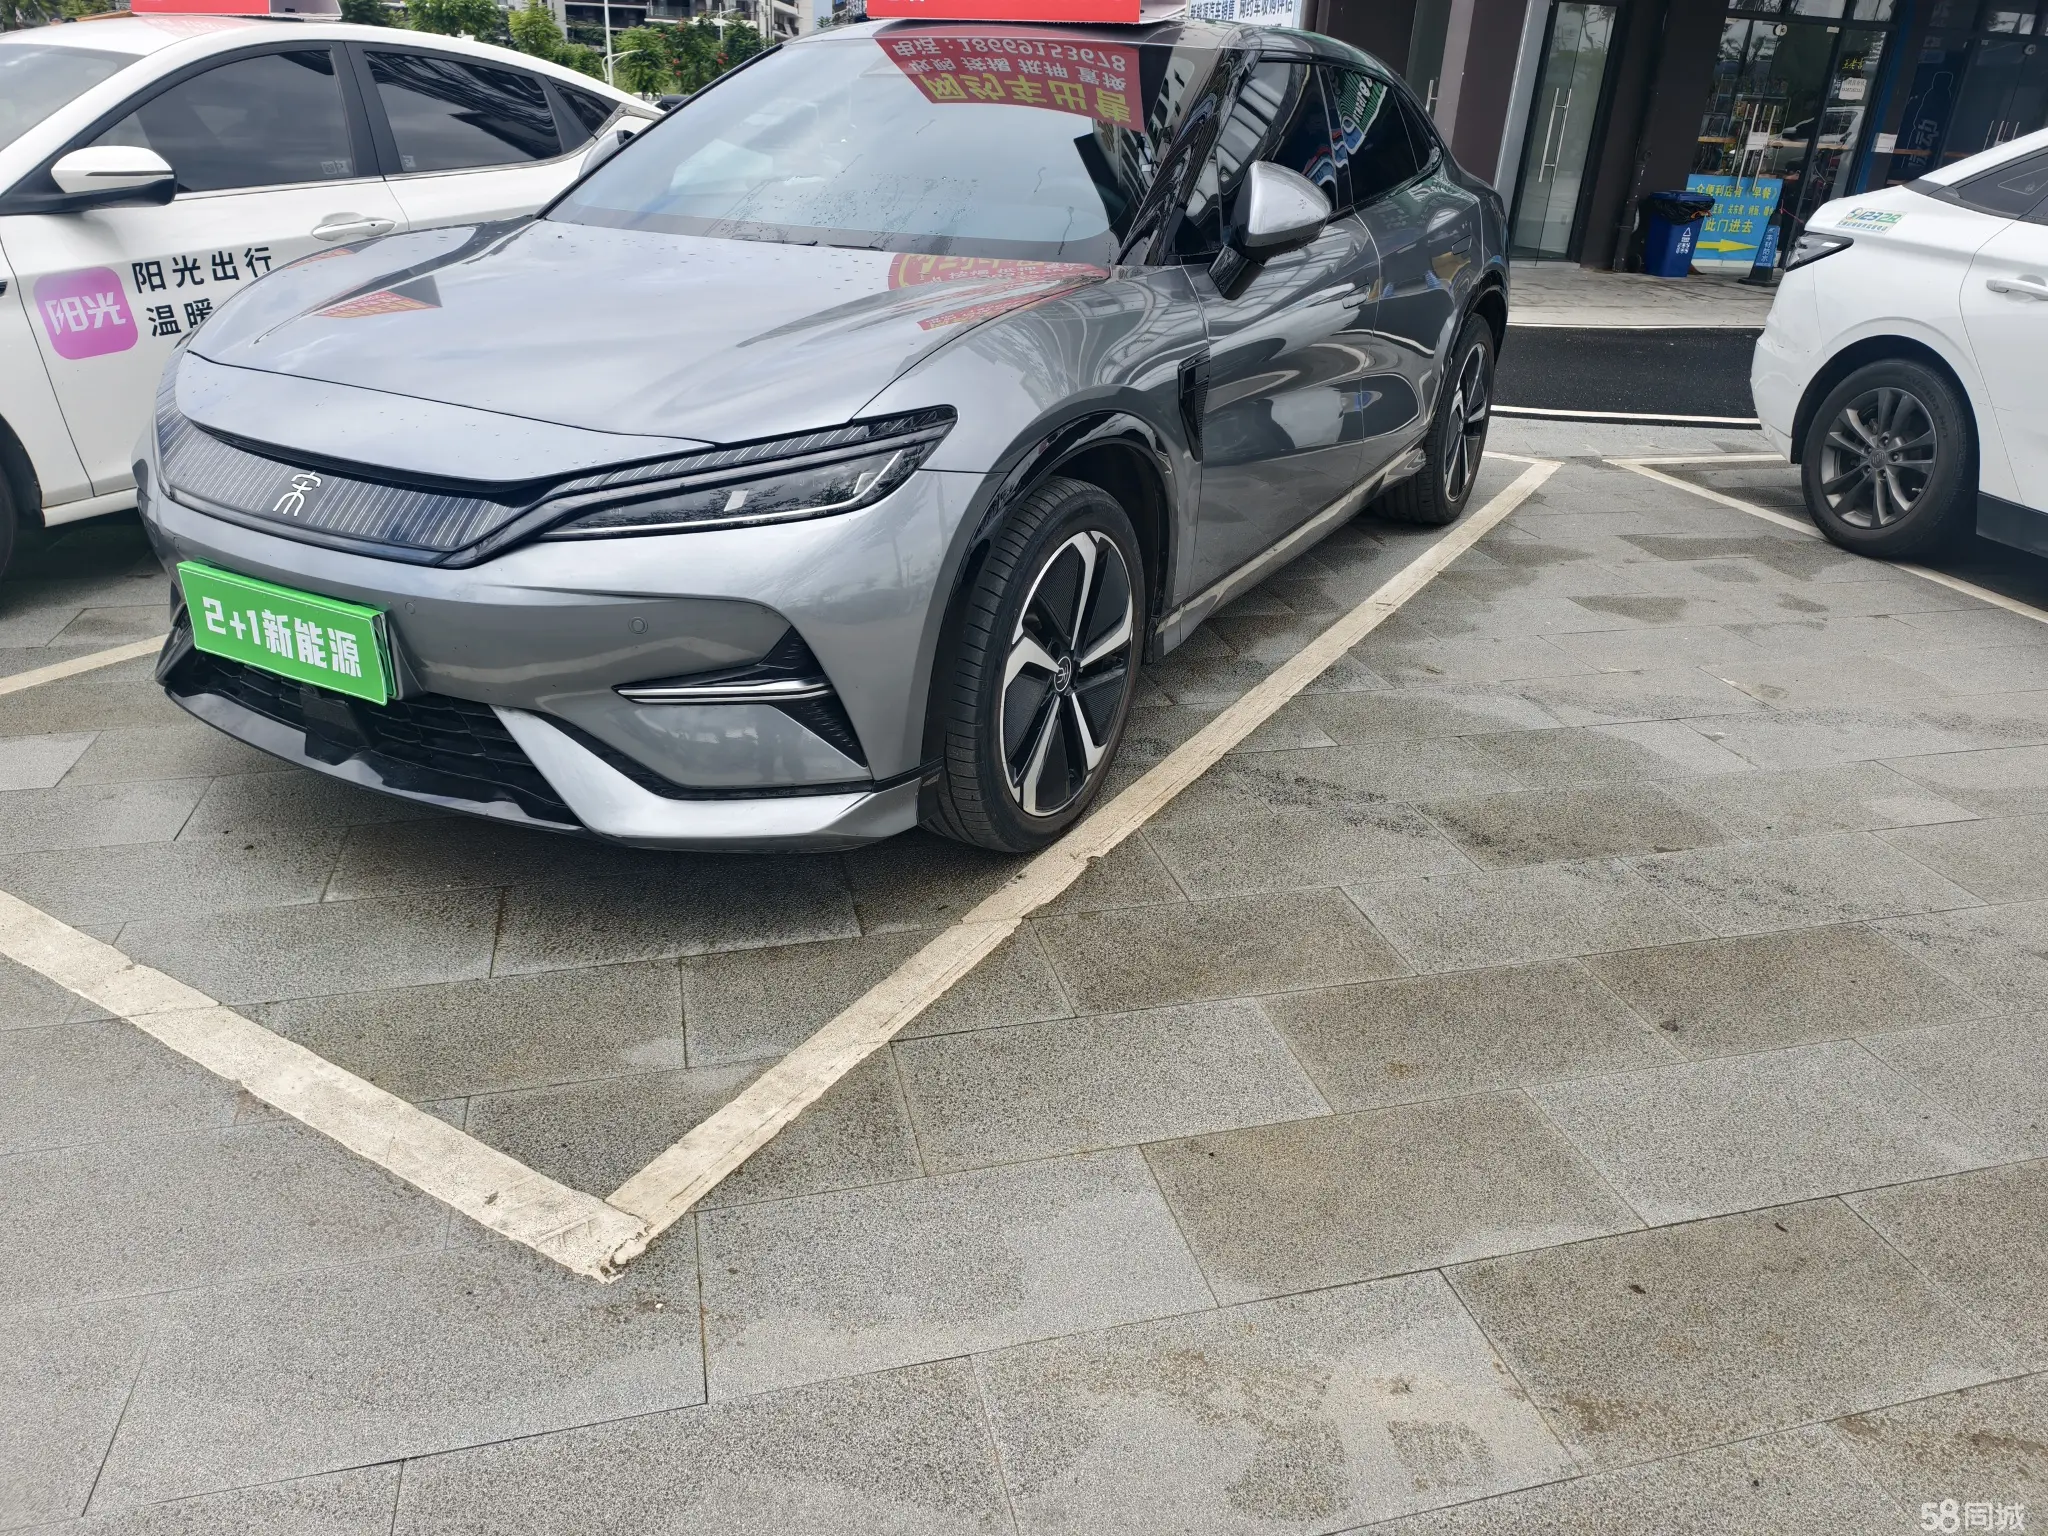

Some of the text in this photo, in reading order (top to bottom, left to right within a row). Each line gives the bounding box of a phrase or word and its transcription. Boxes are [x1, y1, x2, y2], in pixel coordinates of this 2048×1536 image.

[131, 246, 272, 294] 阳光出行
[45, 291, 127, 337] 阳光
[202, 596, 362, 678] 2+1新能源
